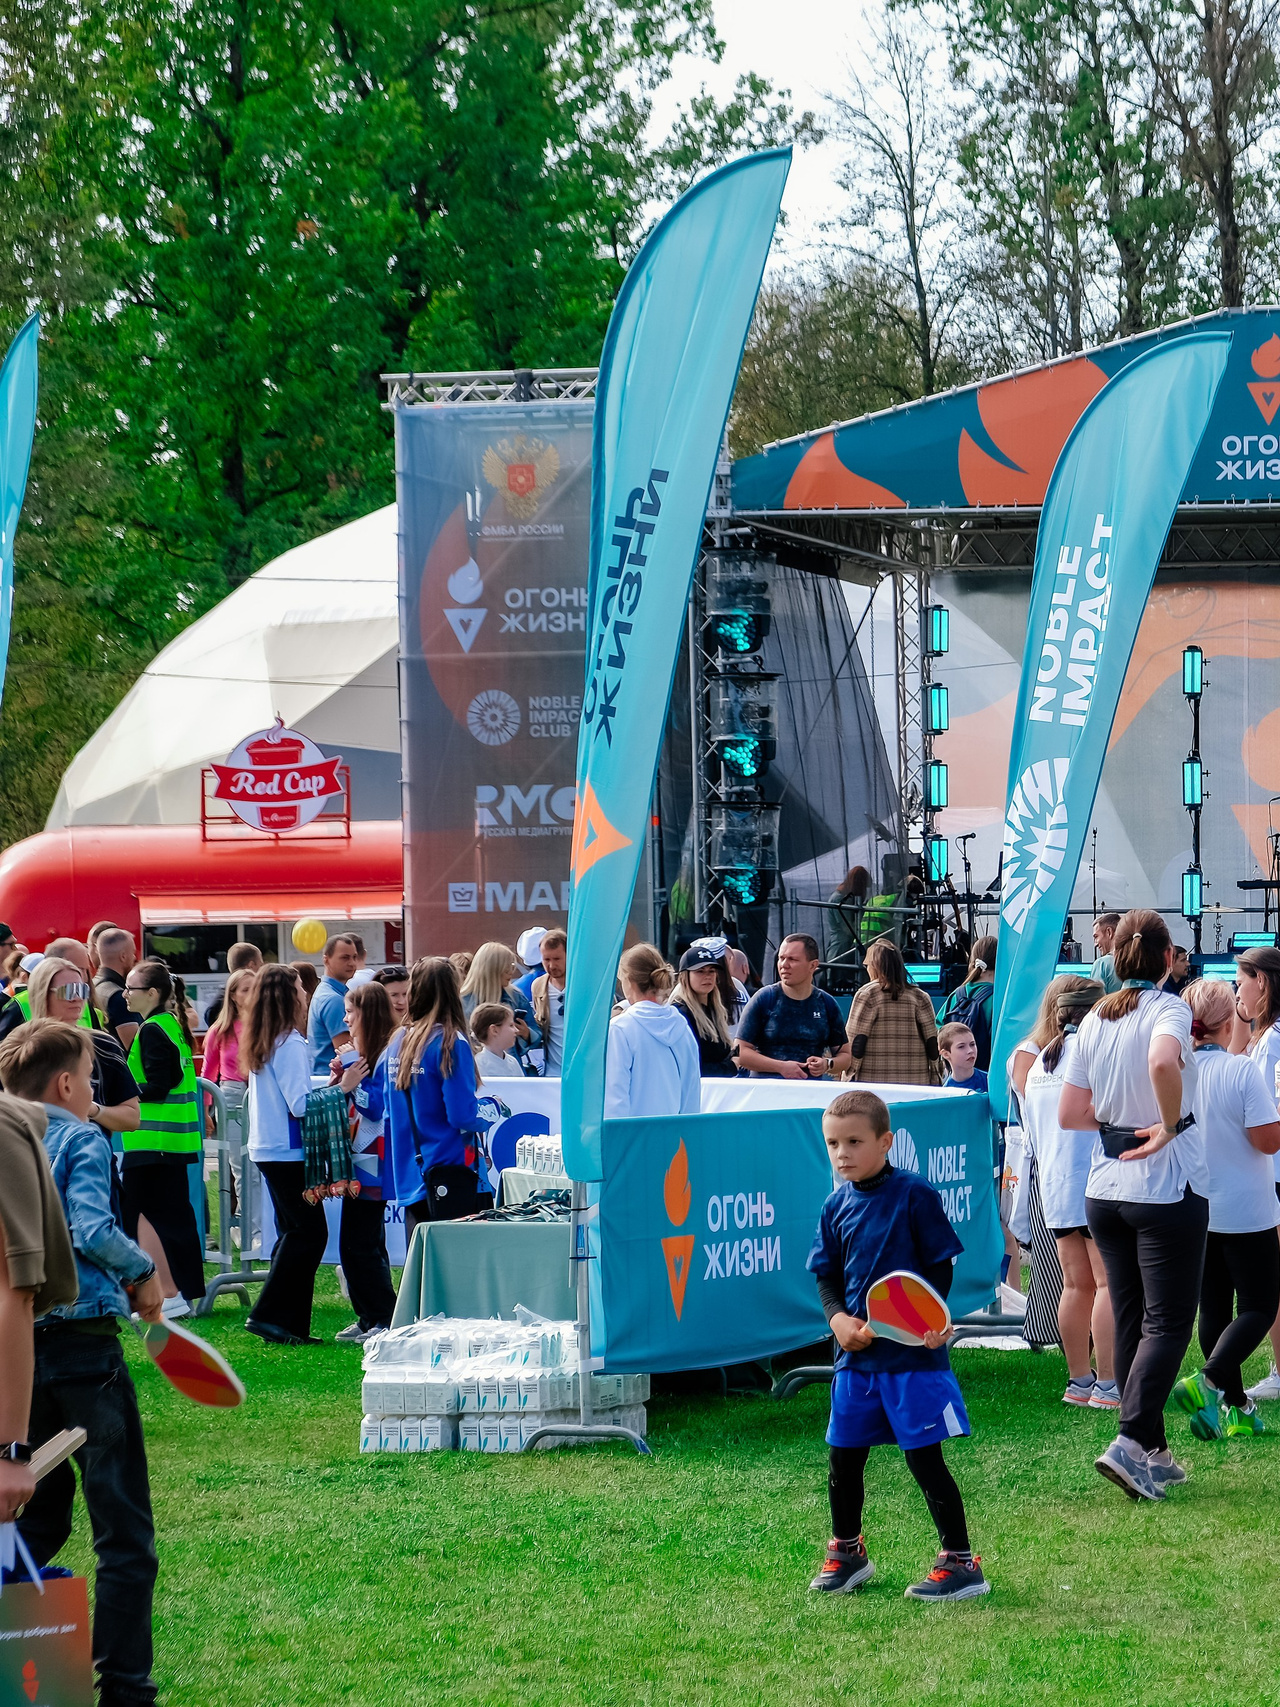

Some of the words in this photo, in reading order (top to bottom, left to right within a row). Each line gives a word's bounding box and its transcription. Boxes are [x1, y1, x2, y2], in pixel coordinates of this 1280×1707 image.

[518, 524, 564, 536] РОССИИ
[498, 611, 586, 634] ЖИЗН
[594, 468, 670, 750] ЖИЗНИ
[1060, 513, 1114, 728] IMPACT
[1029, 545, 1083, 724] NOBLE
[529, 695, 581, 709] NOBLE
[529, 709, 583, 724] IMPAC
[530, 724, 572, 738] CLUB
[229, 771, 282, 796] Red
[283, 771, 326, 797] Cup
[517, 826, 574, 838] МЕДИАГРУПП
[484, 881, 570, 913] MA
[928, 1144, 967, 1184] NOBLE
[707, 1191, 775, 1233] ОГОНЬ
[938, 1185, 973, 1223] PACT
[703, 1235, 782, 1281] ЖИЗНИ
